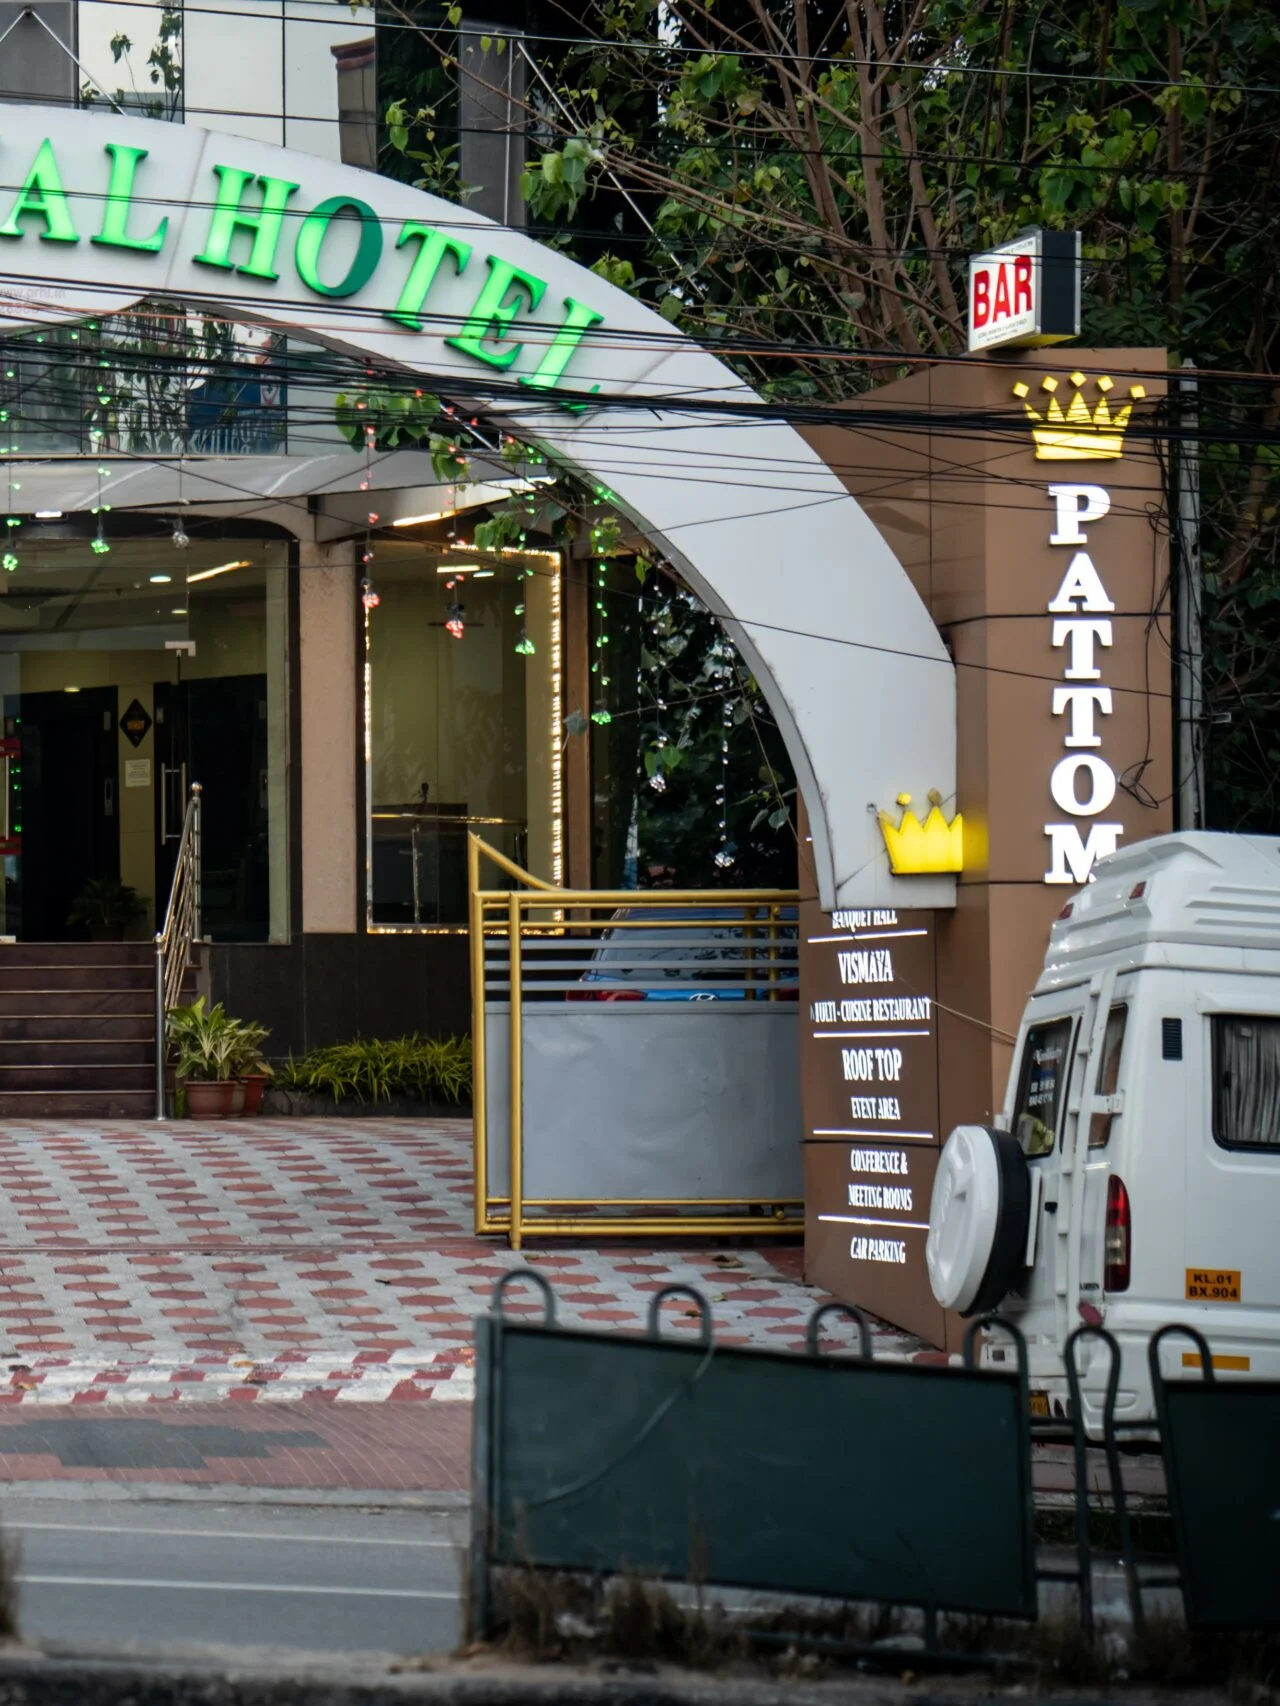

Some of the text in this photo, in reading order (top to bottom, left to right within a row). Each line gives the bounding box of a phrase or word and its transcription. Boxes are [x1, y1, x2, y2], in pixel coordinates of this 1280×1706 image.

[191, 163, 606, 418] HOTEL
[973, 254, 1033, 330] BAR
[1044, 483, 1124, 885] PATTOM
[837, 949, 895, 984] VISMAYA
[810, 1001, 837, 1023] MULTI
[840, 1000, 873, 1023] CUISINE
[872, 997, 932, 1021] RESTAURANT
[842, 1048, 903, 1081] ROOF TOP
[850, 1096, 901, 1120] EVENT AREA
[850, 1149, 908, 1175] CONFERENCE &
[848, 1184, 913, 1211] MEETING ROOMS
[850, 1237, 907, 1264] CAR PARKING
[1188, 1285, 1239, 1299] BX.904
[1193, 1272, 1233, 1285] KL.01
